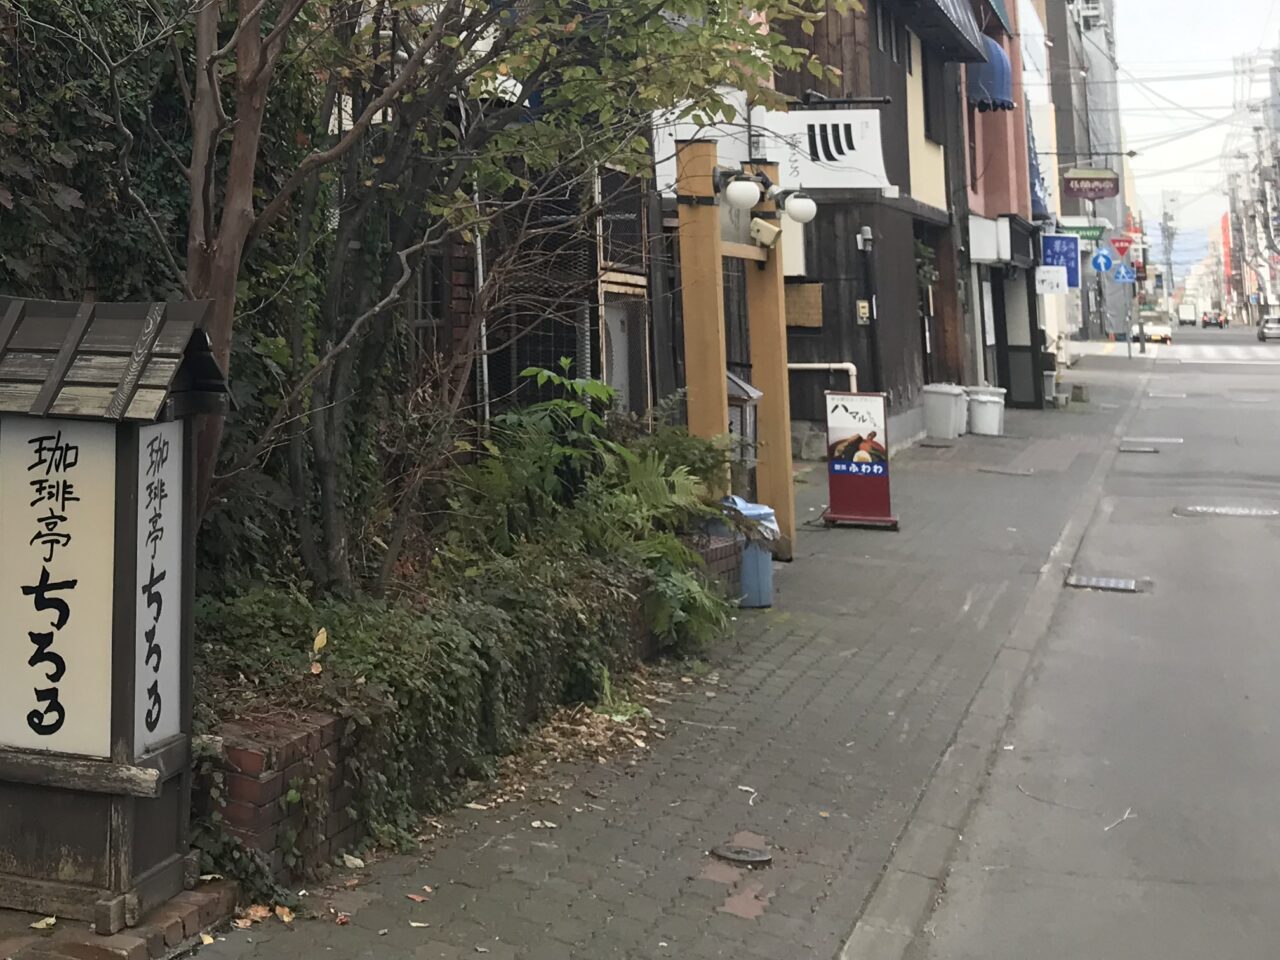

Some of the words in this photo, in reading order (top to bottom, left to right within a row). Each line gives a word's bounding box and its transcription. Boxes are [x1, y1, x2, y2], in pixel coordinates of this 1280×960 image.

[20, 430, 80, 735] 珈琲亭ちろる
[142, 432, 170, 733] 珈琲亭ちろる
